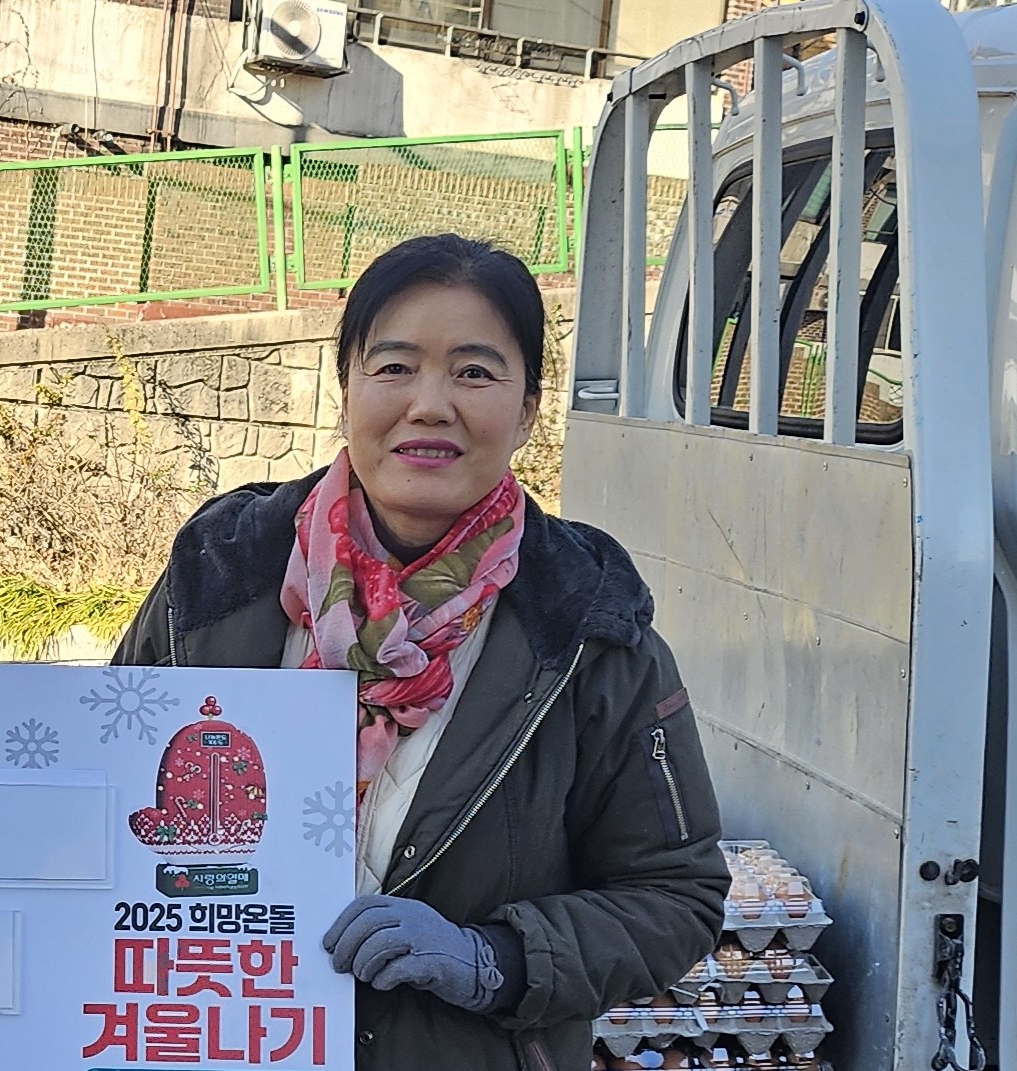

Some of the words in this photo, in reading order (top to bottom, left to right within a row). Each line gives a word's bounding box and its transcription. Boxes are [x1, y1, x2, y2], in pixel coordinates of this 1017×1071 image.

[192, 872, 249, 886] 사랑의열매
[113, 901, 183, 932] 2025
[188, 902, 296, 935] 희망온돌
[113, 937, 299, 999] 따뜻한
[82, 1002, 326, 1066] 겨울나기
